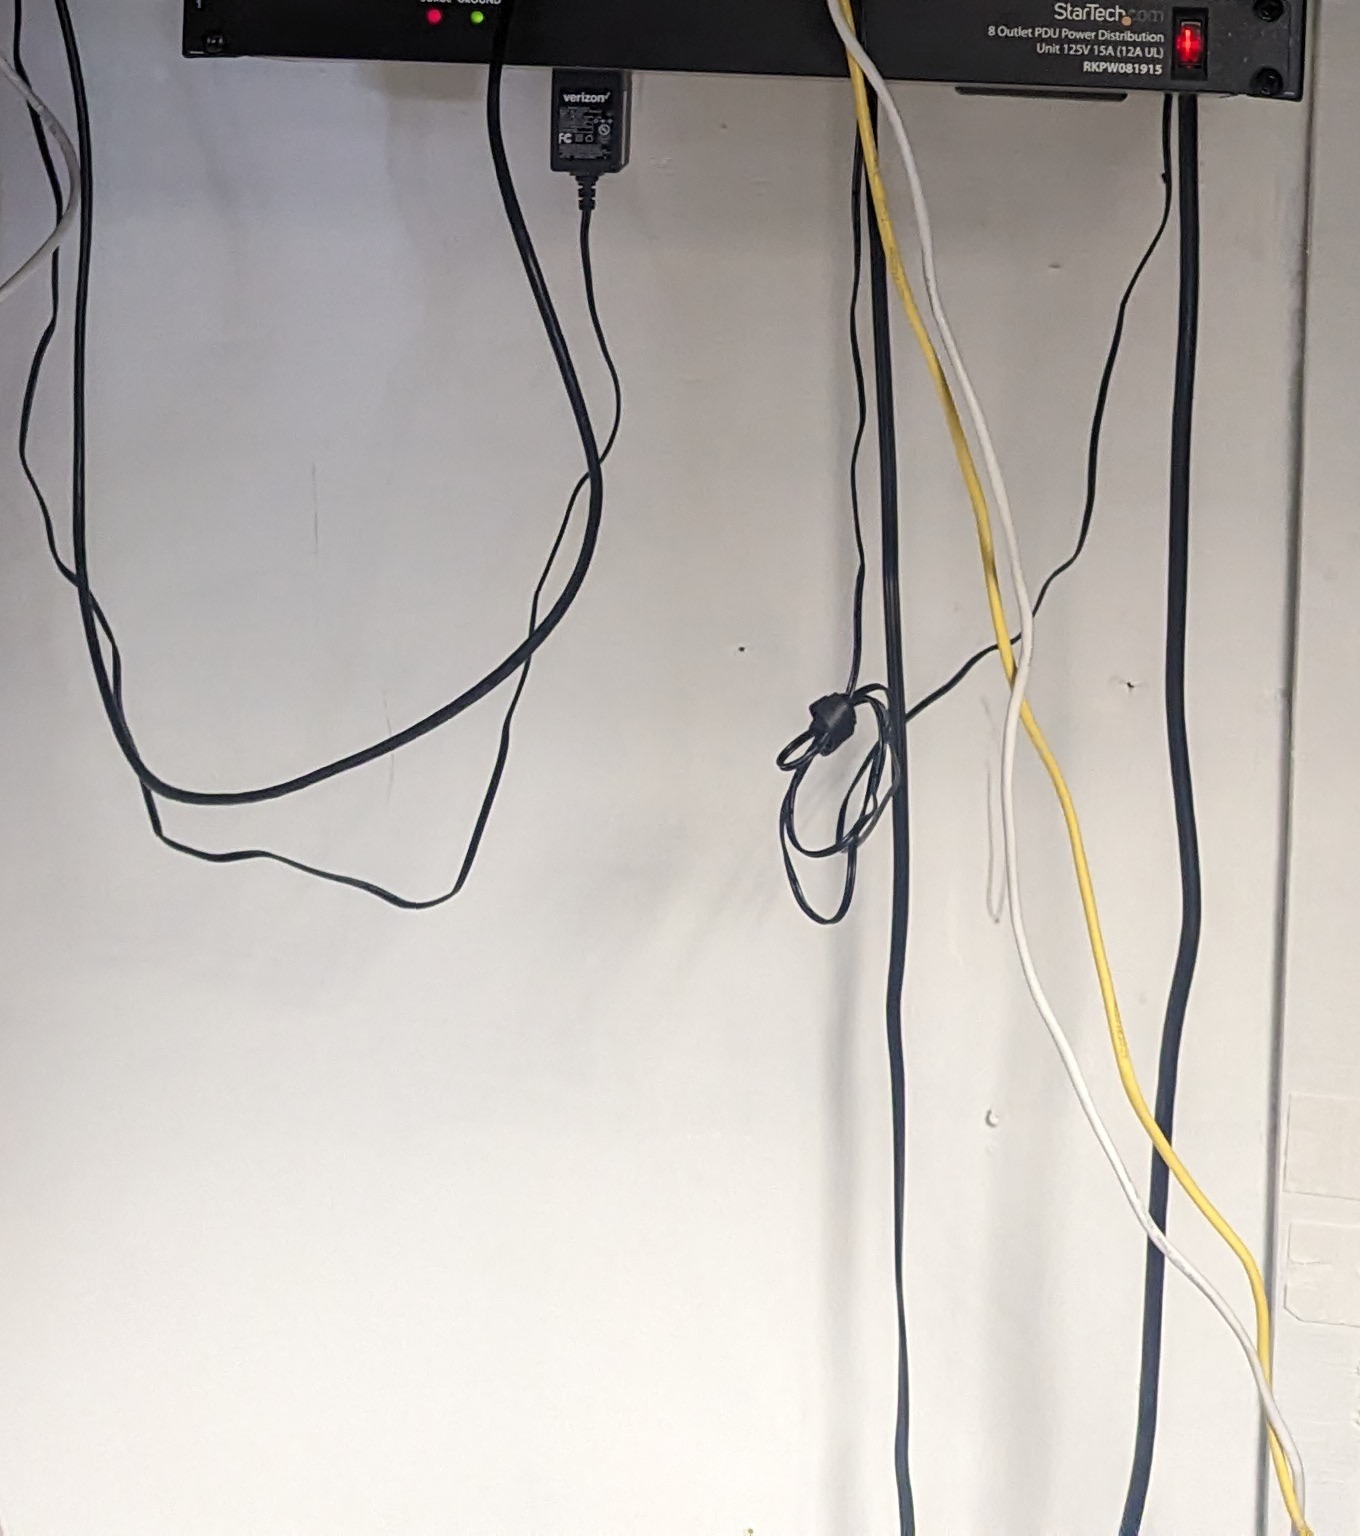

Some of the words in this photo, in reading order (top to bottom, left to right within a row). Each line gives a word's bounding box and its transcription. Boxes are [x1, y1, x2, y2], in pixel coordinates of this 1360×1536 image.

[987, 25, 996, 37] 8
[997, 25, 1033, 38] Outlet
[1034, 26, 1060, 39] PDU
[1061, 28, 1096, 41] Power
[1097, 29, 1165, 43] Distribution
[1036, 42, 1061, 55] Unit
[1062, 43, 1091, 56] 125V
[1093, 44, 1115, 57] 15A
[1116, 45, 1143, 59] (12A
[1144, 46, 1164, 60] UL)
[1082, 60, 1164, 76] RKPW081915
[562, 91, 606, 103] verizon
